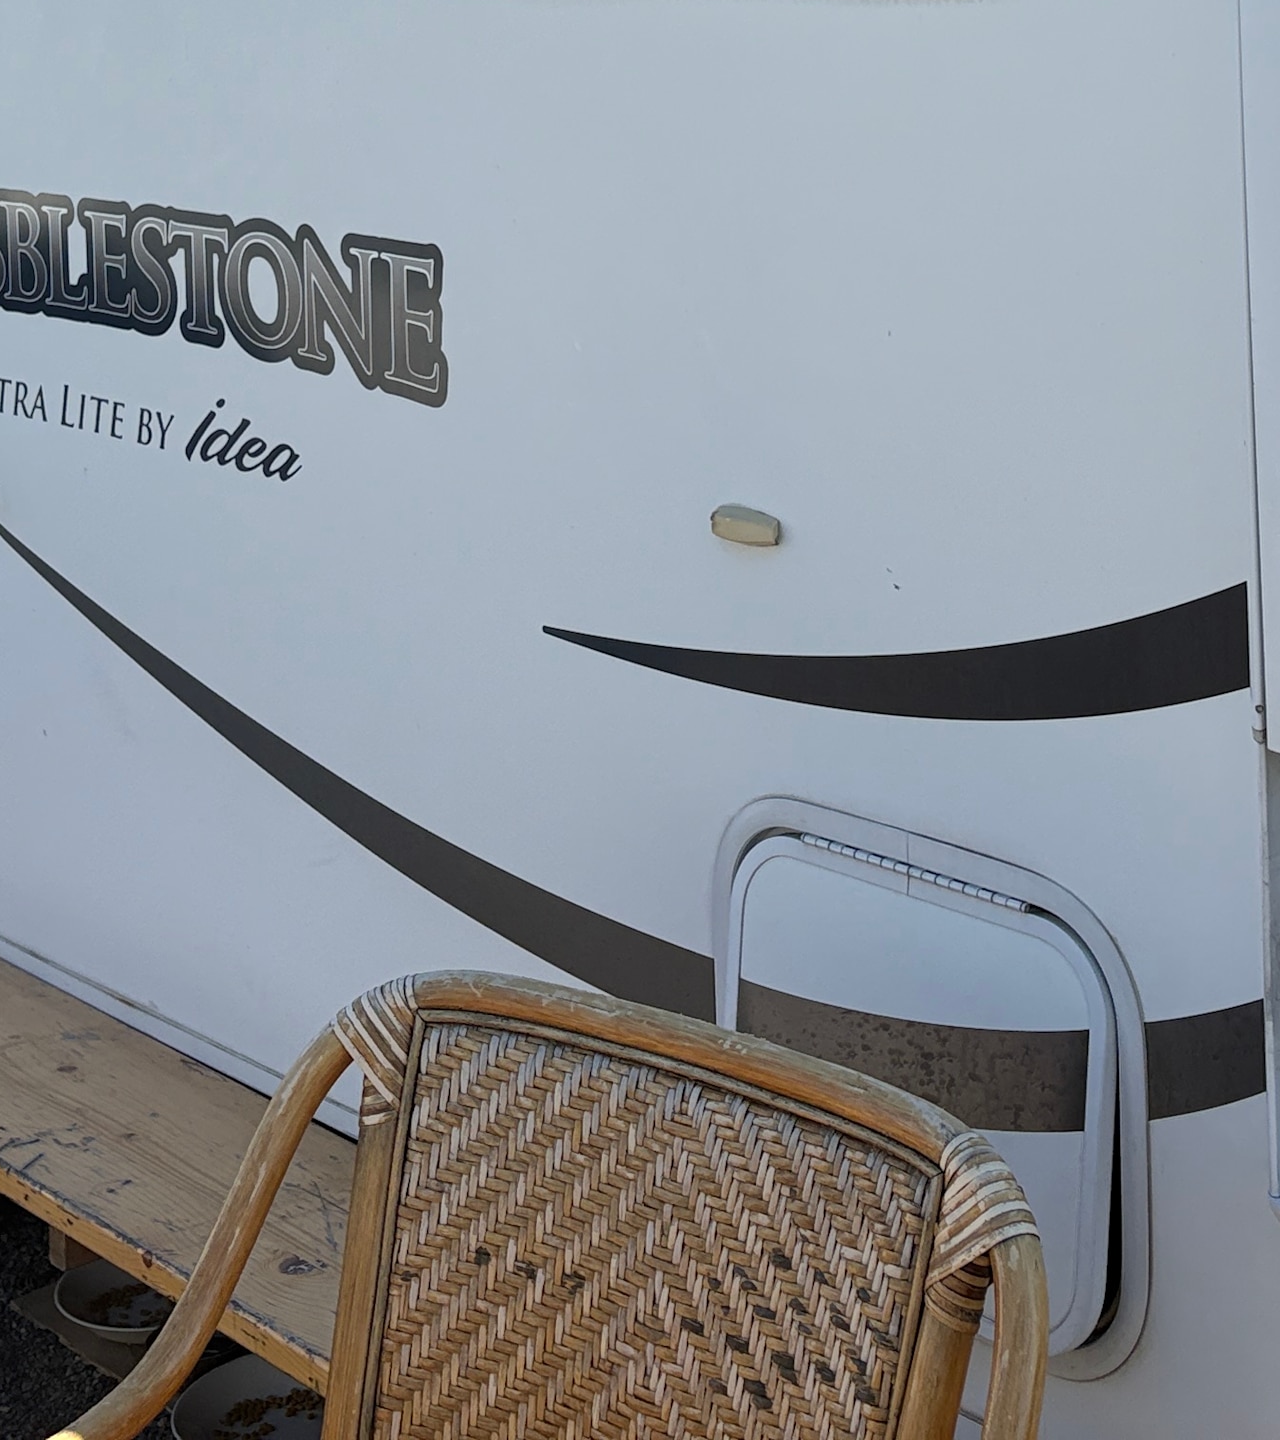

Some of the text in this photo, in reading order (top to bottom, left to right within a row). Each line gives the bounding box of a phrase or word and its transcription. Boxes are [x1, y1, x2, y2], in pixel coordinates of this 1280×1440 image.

[60, 384, 126, 440] LITE
[137, 407, 175, 450] BY
[185, 398, 303, 482] idea
